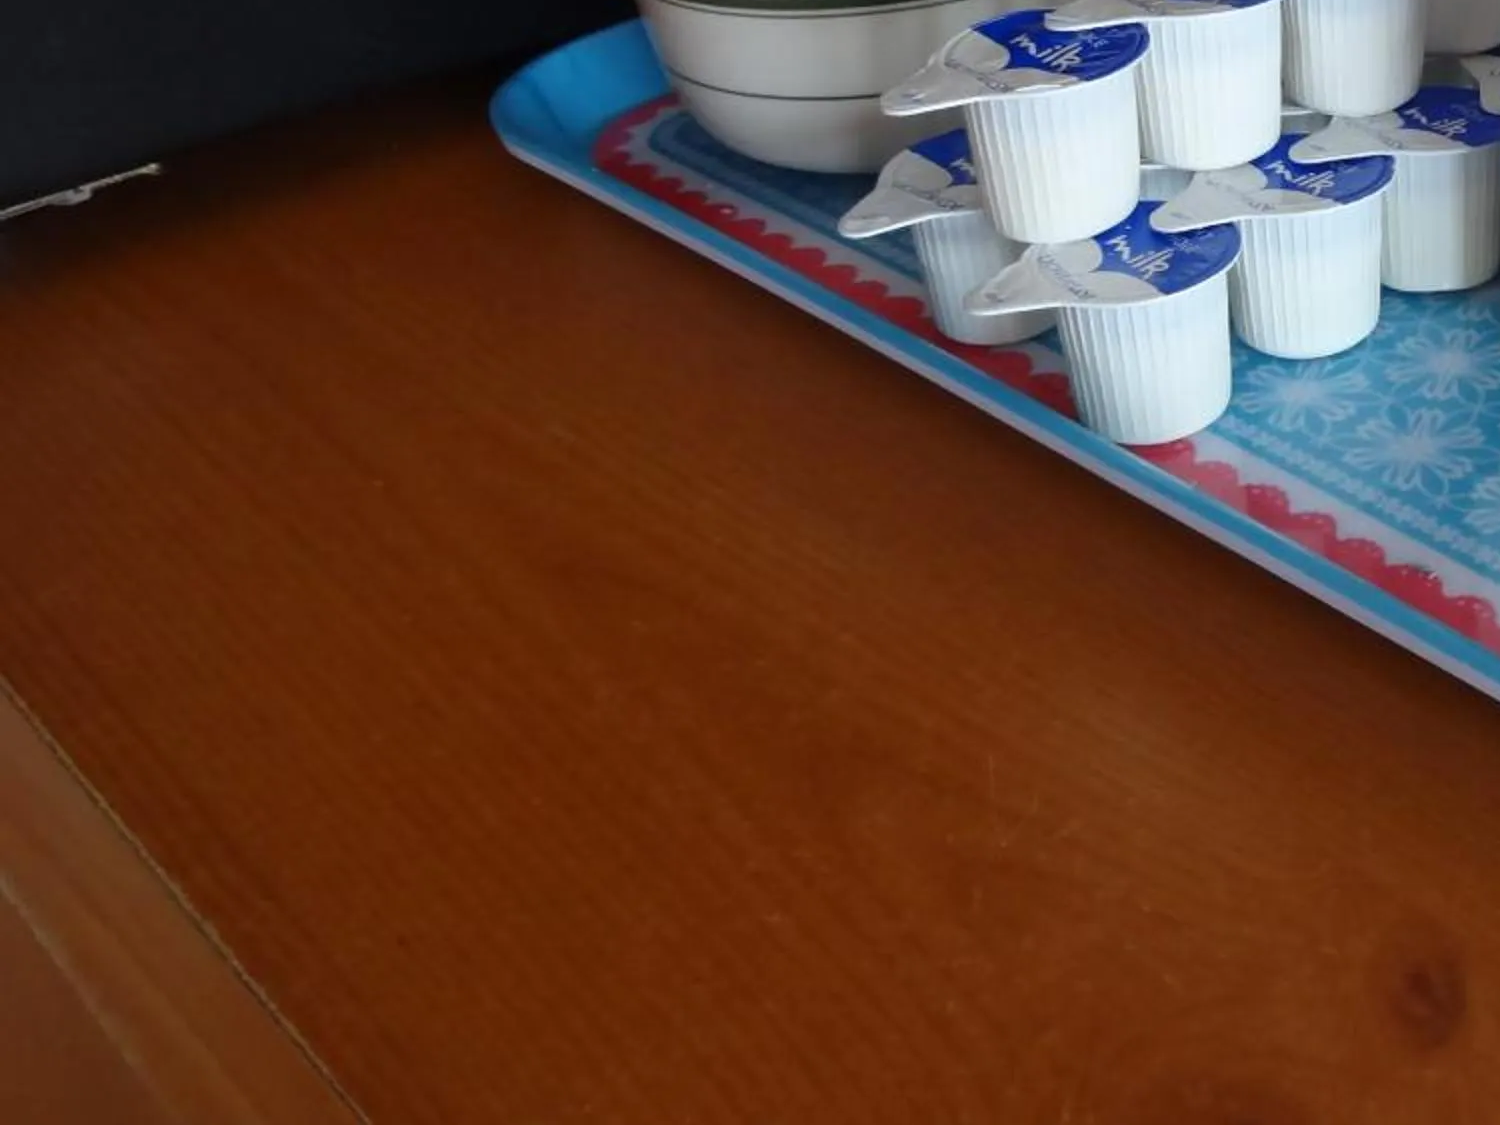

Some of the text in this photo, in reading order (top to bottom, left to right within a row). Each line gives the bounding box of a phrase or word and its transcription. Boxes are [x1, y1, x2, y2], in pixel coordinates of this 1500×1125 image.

[1009, 33, 1084, 72] milk
[1263, 160, 1336, 197] milk
[1105, 233, 1175, 280] milk
